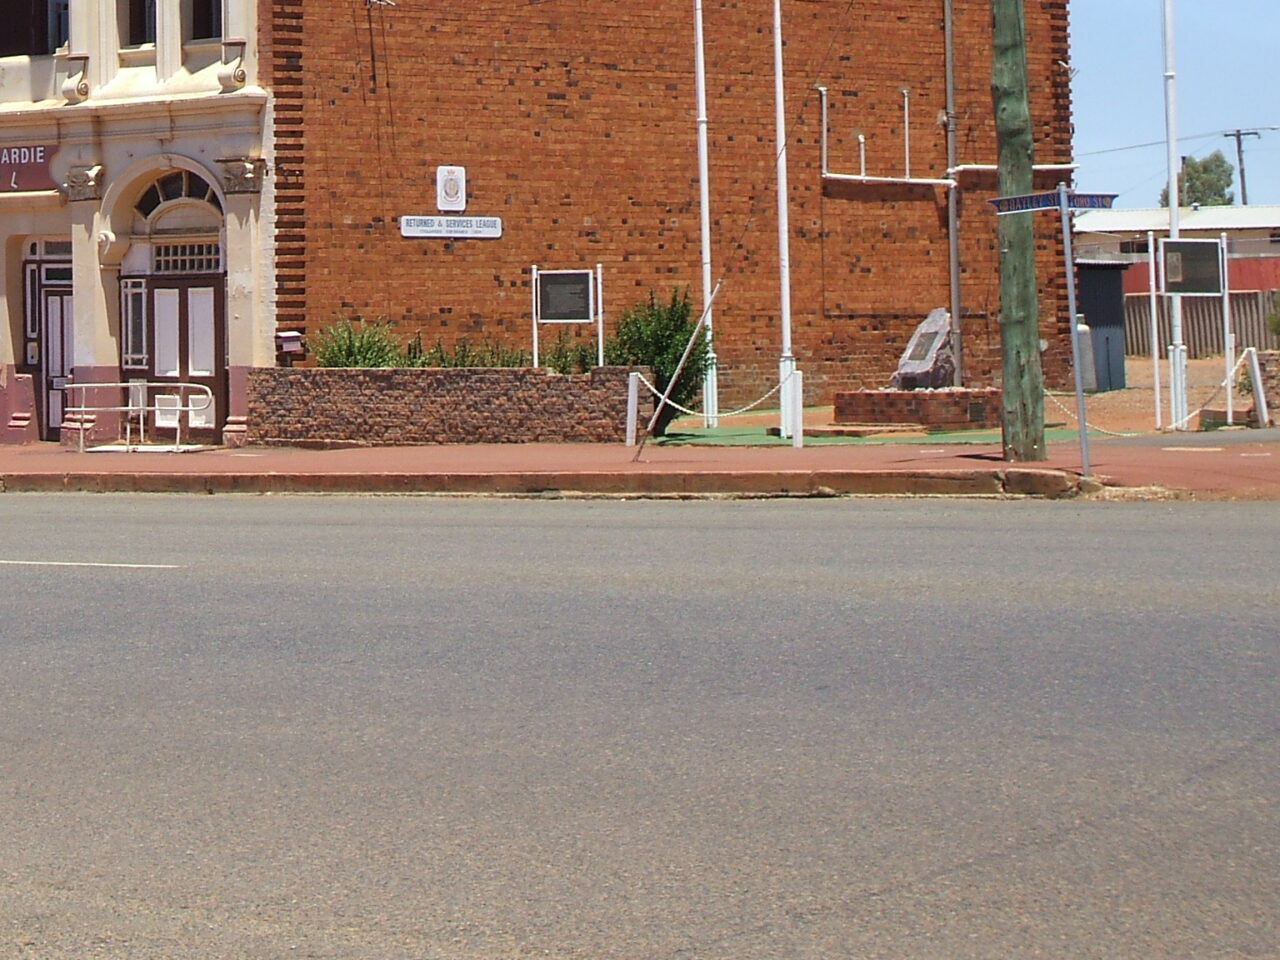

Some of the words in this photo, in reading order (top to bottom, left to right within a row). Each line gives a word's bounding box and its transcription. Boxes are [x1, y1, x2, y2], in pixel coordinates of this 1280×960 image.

[10, 171, 18, 189] L
[445, 219, 473, 229] SERVICES
[475, 220, 498, 229] LEAGUE
